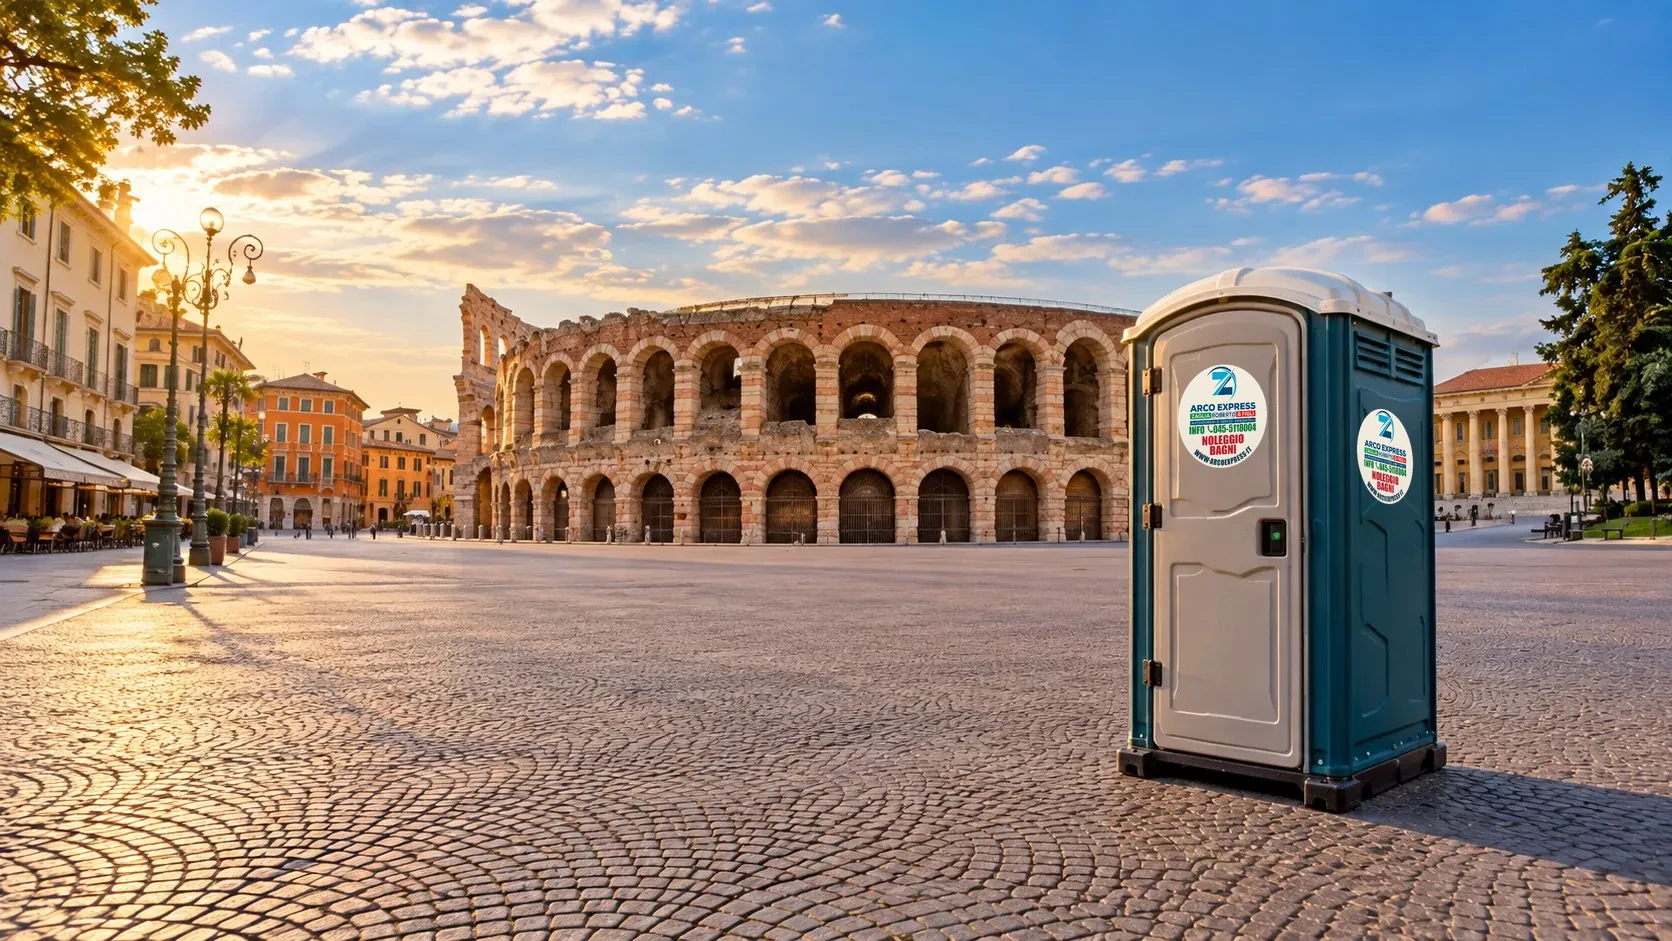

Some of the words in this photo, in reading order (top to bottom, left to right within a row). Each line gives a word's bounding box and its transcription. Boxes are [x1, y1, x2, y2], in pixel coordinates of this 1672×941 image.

[1190, 404, 1215, 412] ARCO
[1217, 402, 1256, 411] EXPRESS
[1189, 426, 1204, 434] INFO
[1213, 423, 1256, 434] 045-5118004
[1202, 434, 1244, 446] NOLEGGIO
[1209, 445, 1237, 455] BAGNI
[1364, 440, 1381, 450] ARCO
[1381, 444, 1406, 457] EXPRESS
[1364, 459, 1374, 469] INFO
[1371, 470, 1399, 485] NOLEGGIO
[1377, 482, 1395, 493] BAGNI
